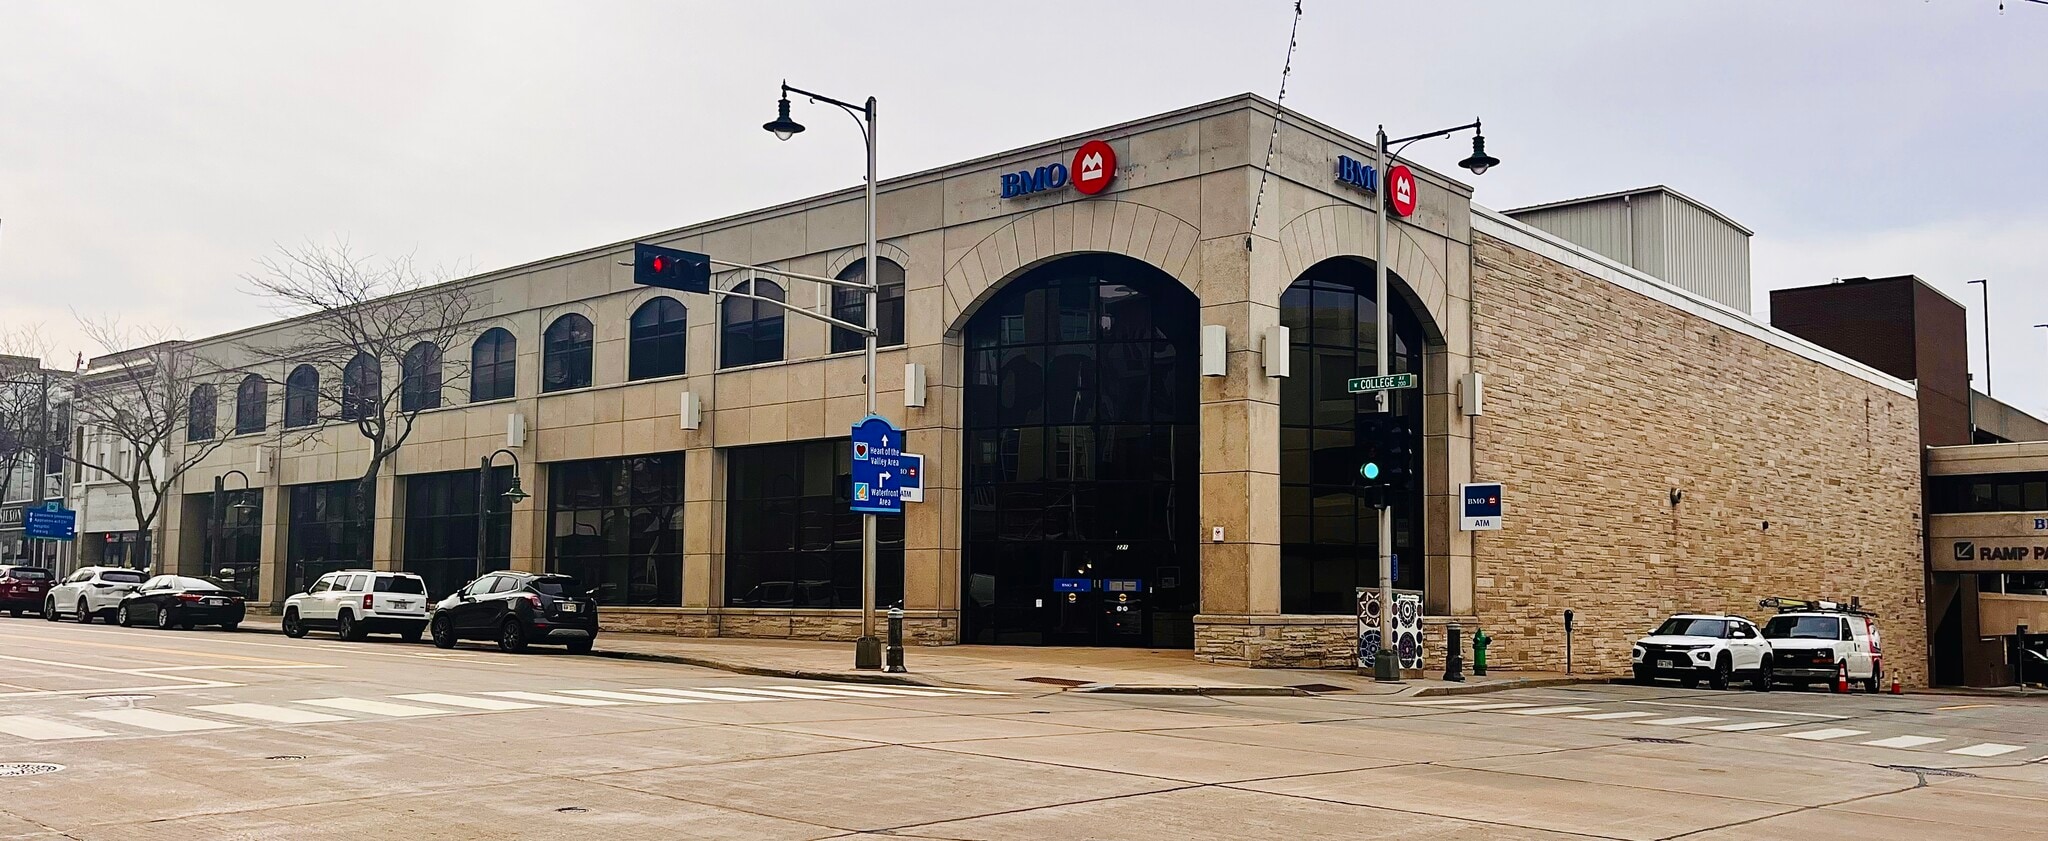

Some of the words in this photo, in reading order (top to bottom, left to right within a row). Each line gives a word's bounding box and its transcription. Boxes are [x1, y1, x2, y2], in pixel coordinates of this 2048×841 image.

[1337, 155, 1377, 194] BM
[1000, 163, 1067, 199] BMO
[1360, 376, 1395, 389] COLLEGE
[870, 447, 884, 455] Heart
[885, 447, 890, 455] of
[891, 448, 899, 456] the
[871, 457, 887, 467] Valley
[888, 458, 899, 466] Area
[871, 488, 899, 497] Waterfront
[1467, 497, 1486, 505] BMO
[1475, 519, 1490, 527] ATM
[2034, 518, 2048, 530] B
[1980, 546, 2029, 561] RAMP
